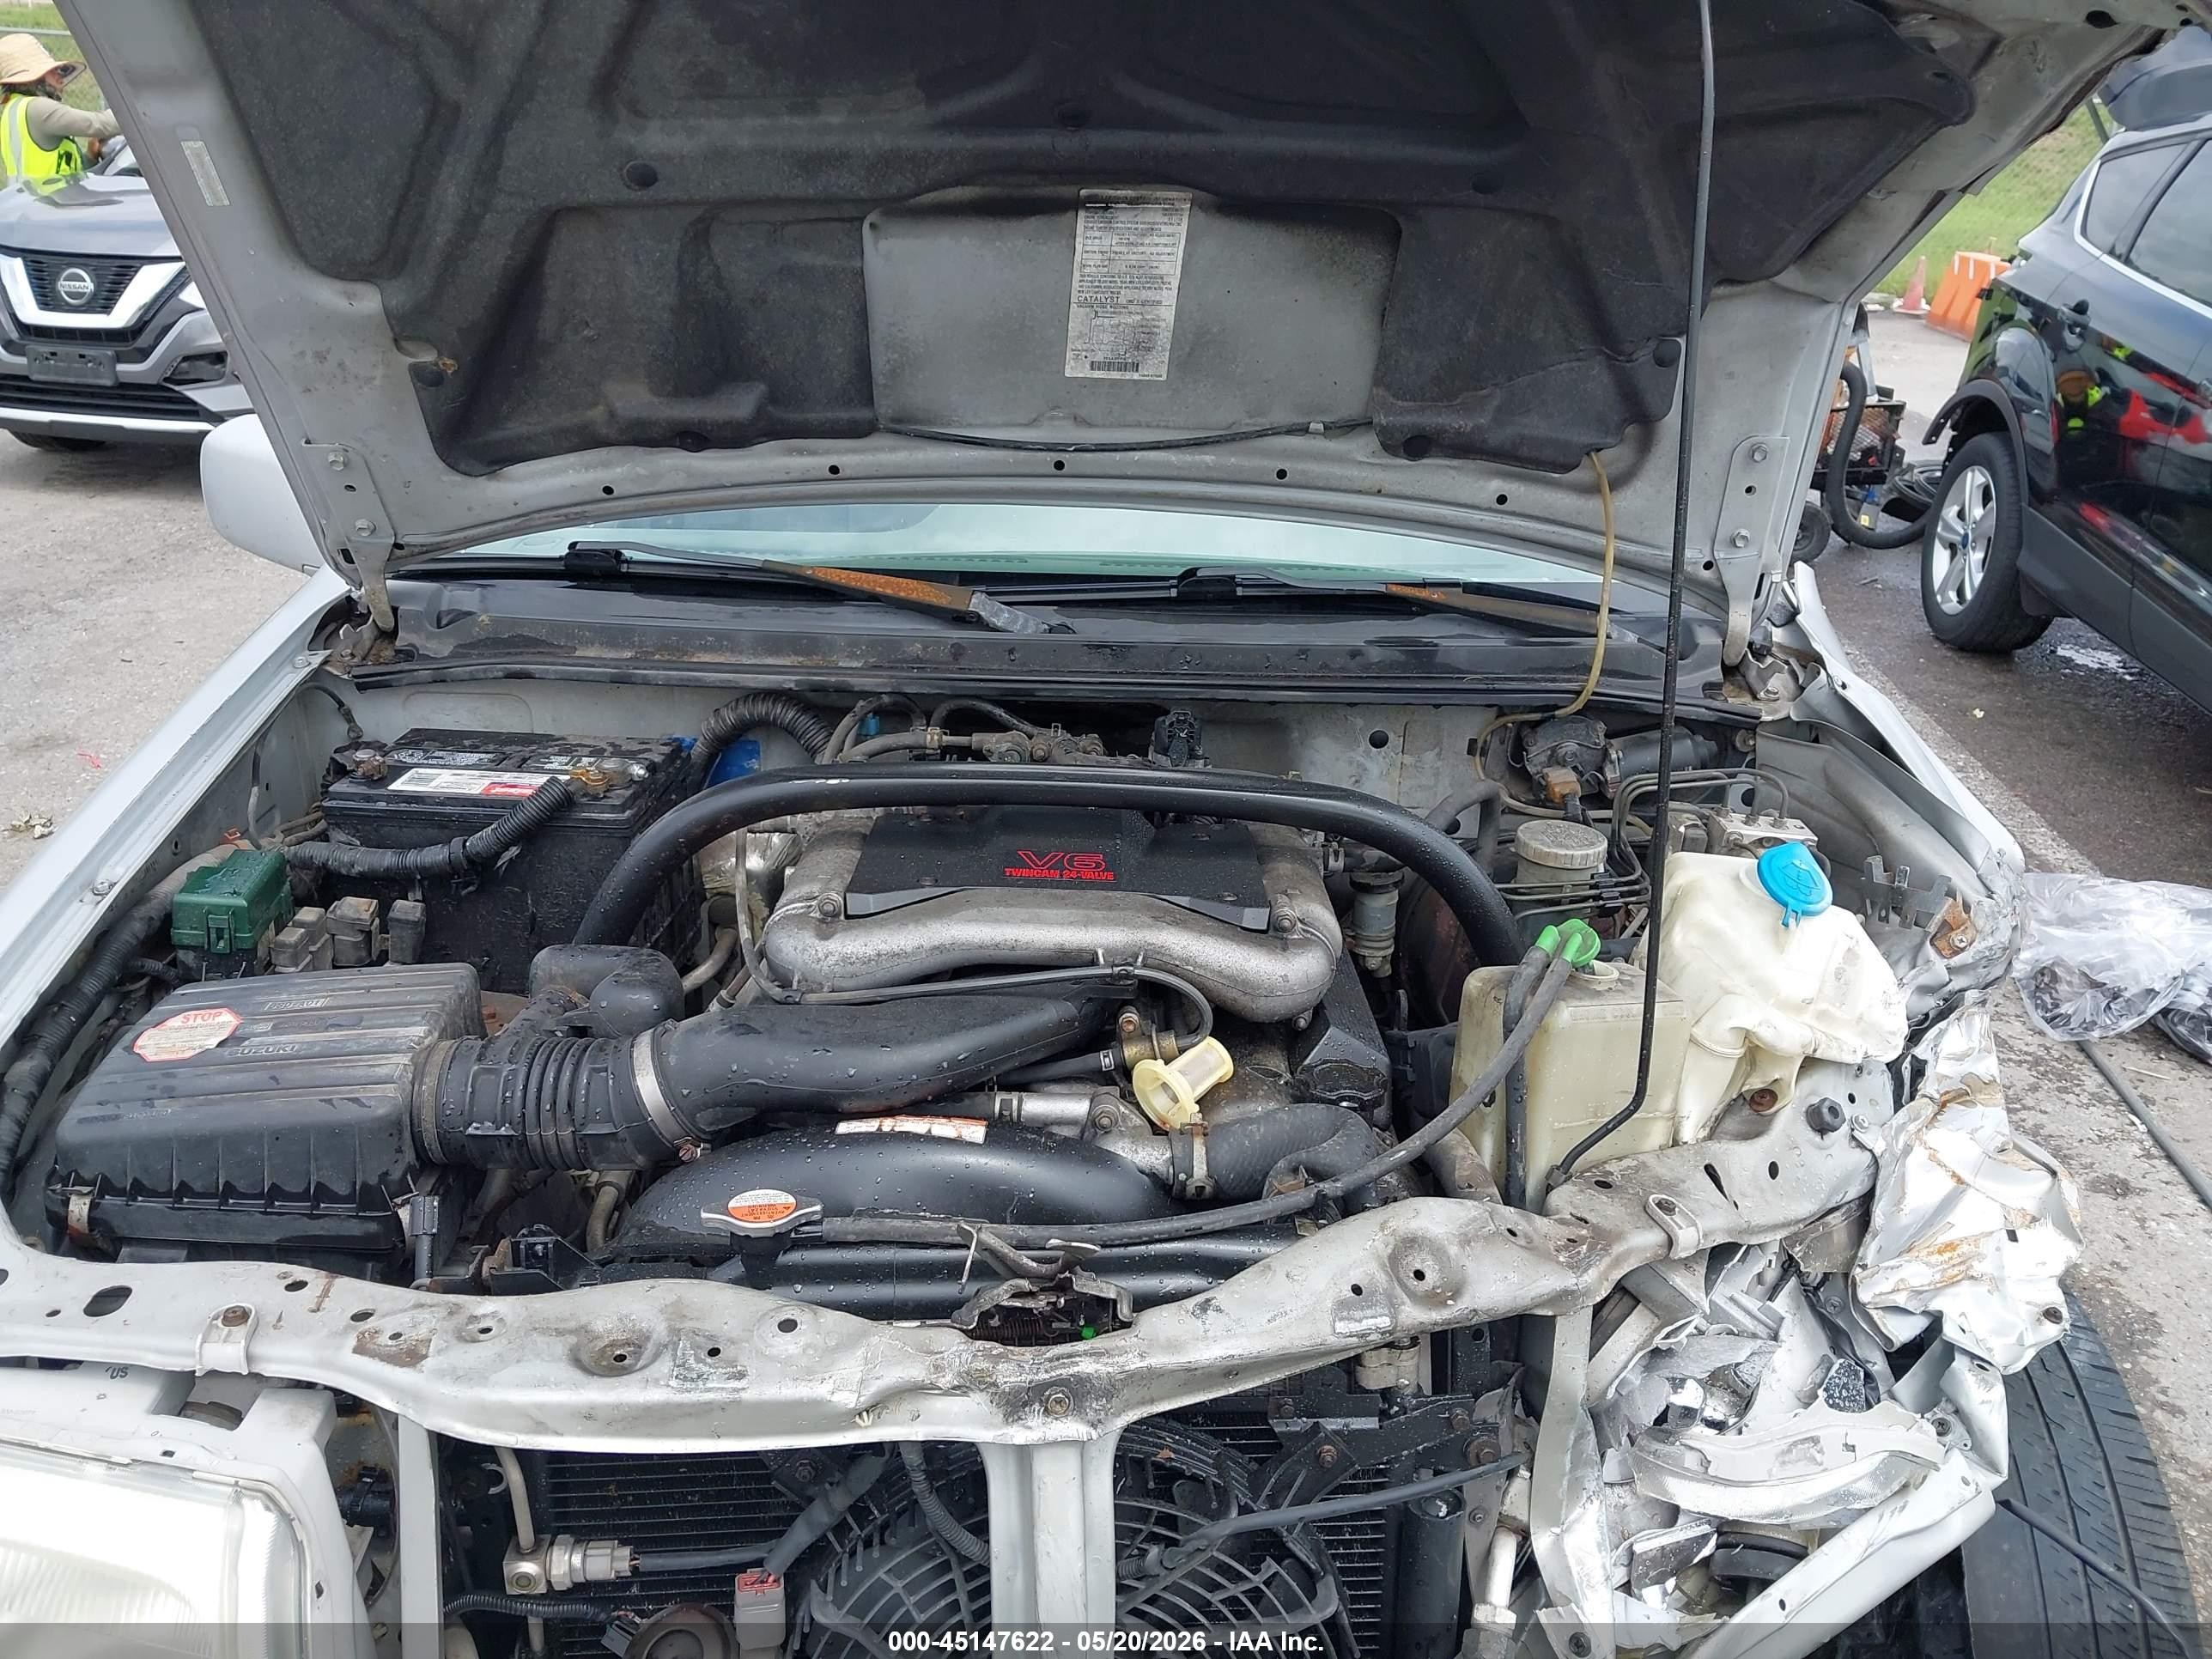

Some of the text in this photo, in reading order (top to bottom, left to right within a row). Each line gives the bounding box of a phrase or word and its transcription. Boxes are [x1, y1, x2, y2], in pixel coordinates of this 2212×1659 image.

[1017, 850, 1106, 872] V6
[1004, 867, 1114, 880] TWINCAM 24-VALVE
[180, 1011, 223, 1024] STOP
[228, 1044, 297, 1057] SUZUKI
